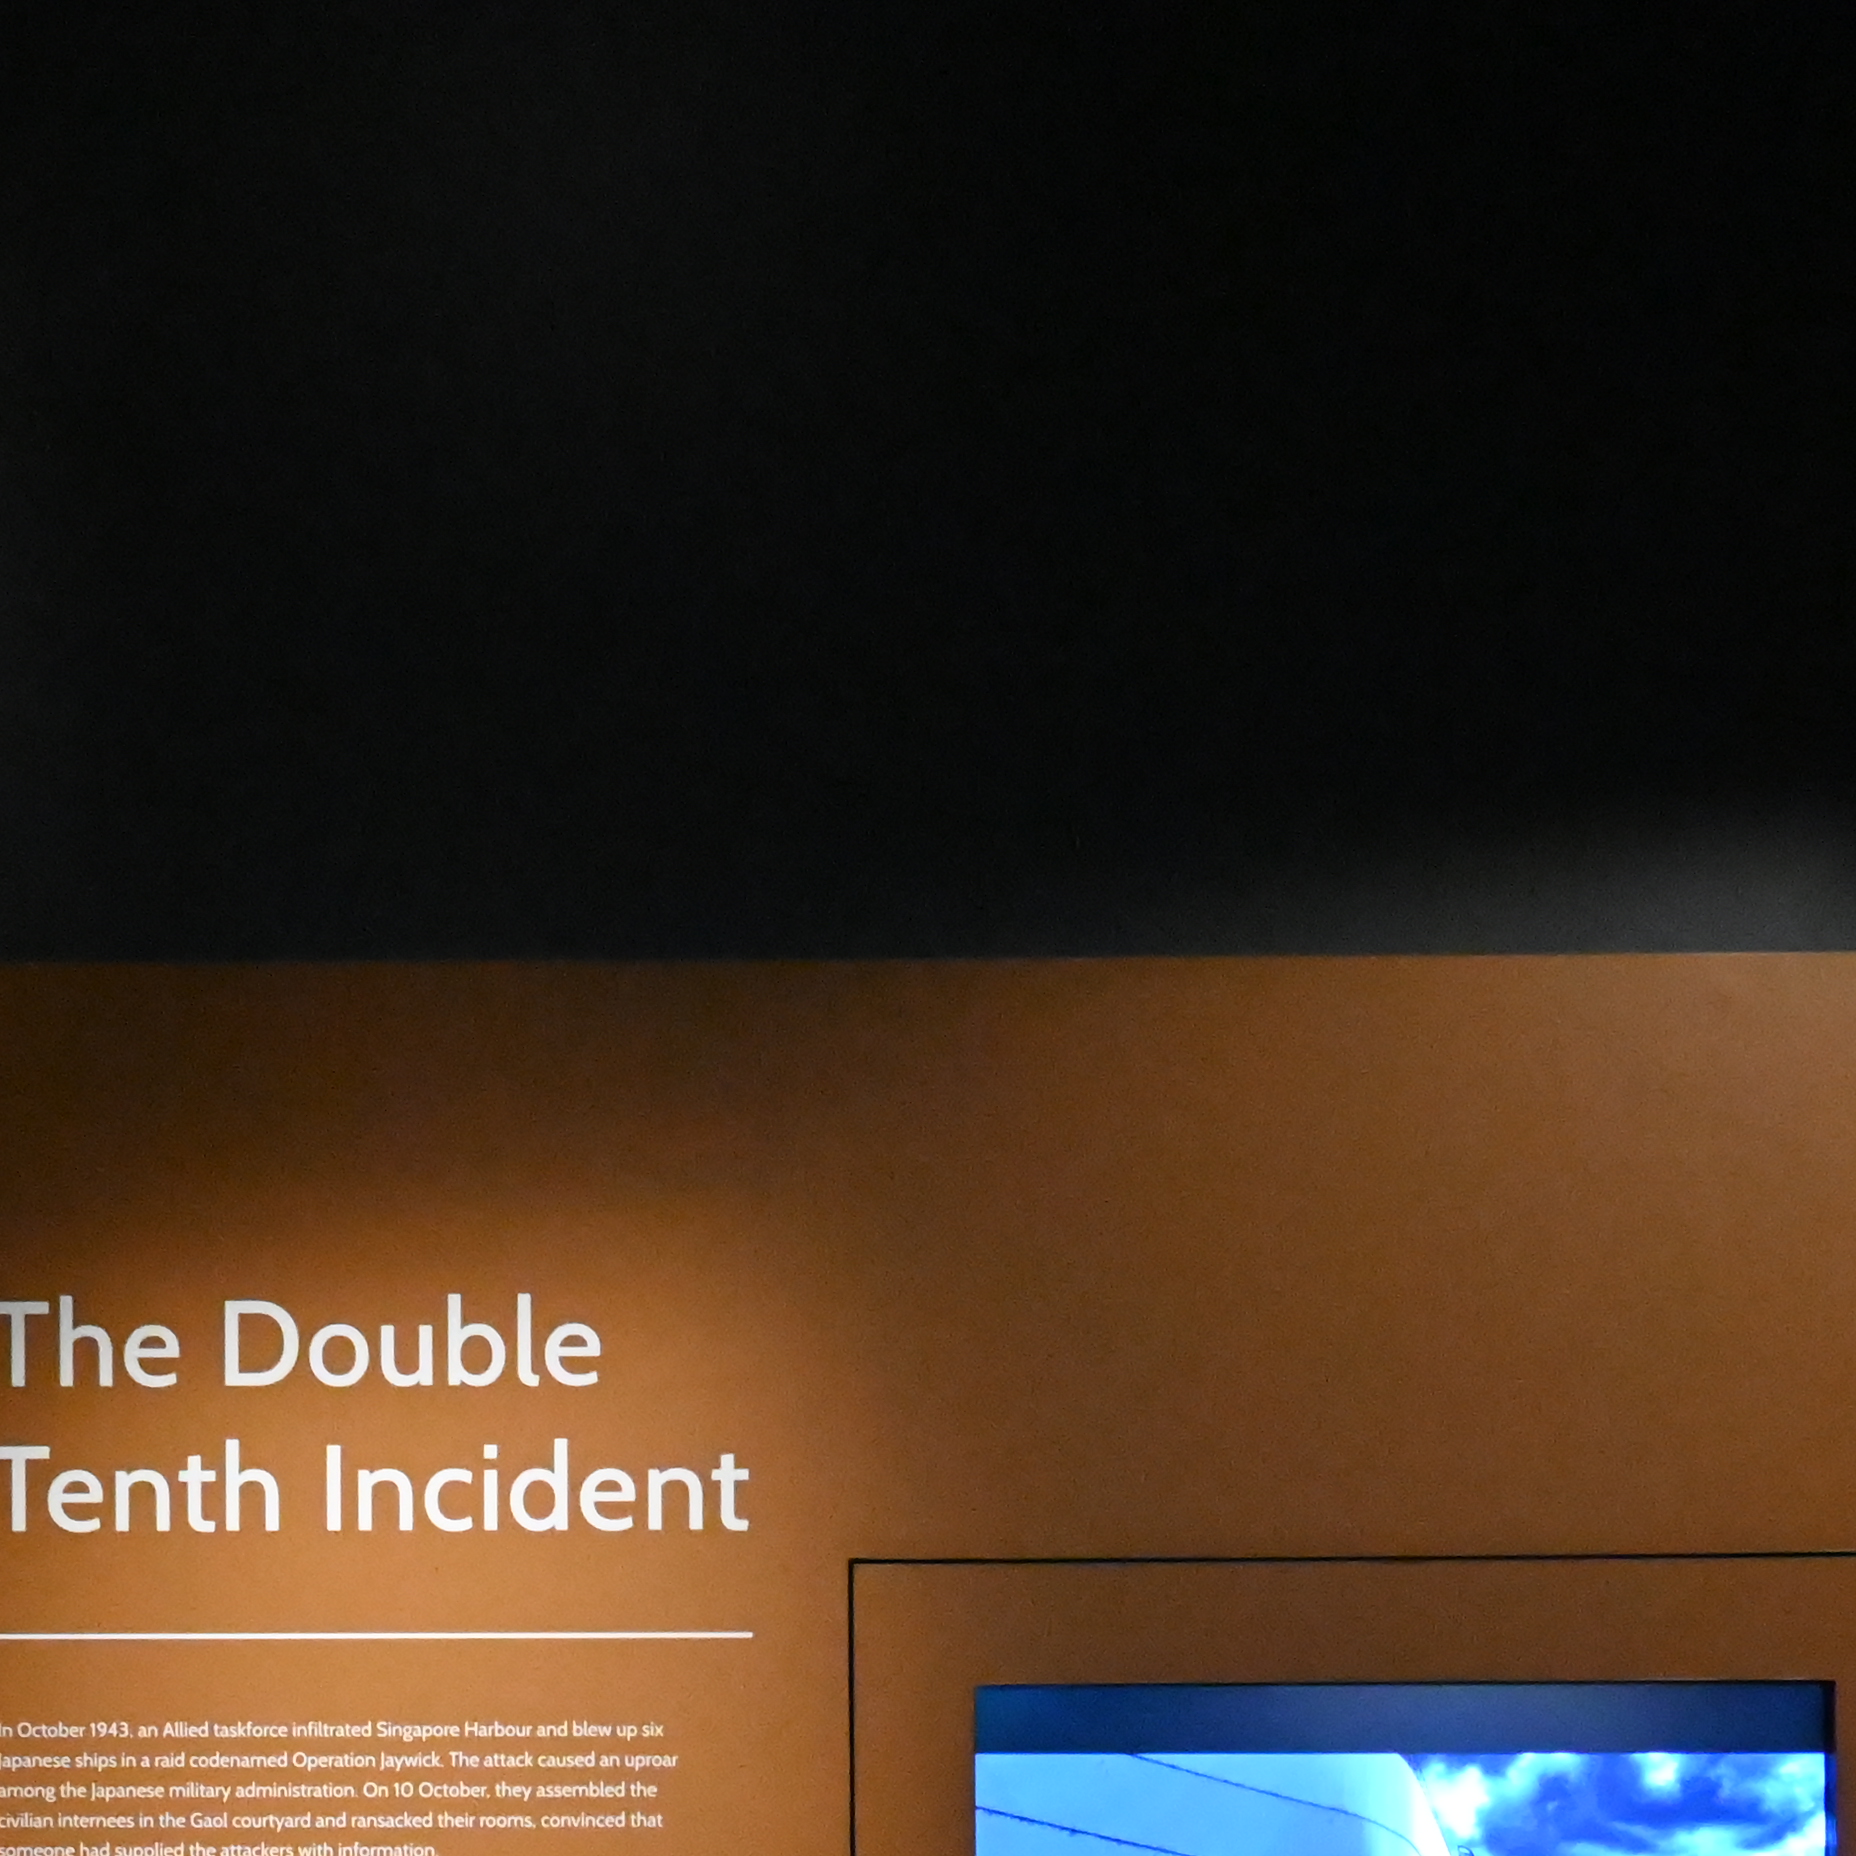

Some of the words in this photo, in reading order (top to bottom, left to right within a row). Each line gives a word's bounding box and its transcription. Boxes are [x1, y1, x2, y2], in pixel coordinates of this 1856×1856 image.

[225, 1294, 600, 1387] Double
[327, 1439, 749, 1531] Incident
[17, 1721, 86, 1738] October
[90, 1722, 133, 1738] 1943,
[138, 1726, 158, 1738] an
[163, 1721, 209, 1738] Allied
[214, 1721, 288, 1738] taskforce
[292, 1721, 372, 1737] infiltrated
[376, 1721, 460, 1742] Singapore
[465, 1721, 532, 1737] Harbour
[536, 1720, 568, 1737] and
[572, 1720, 611, 1737] blew
[616, 1725, 637, 1741] up
[642, 1722, 663, 1737] six
[75, 1752, 117, 1772] ships
[121, 1752, 136, 1767] in
[141, 1756, 150, 1767] a
[154, 1751, 185, 1768] raid
[189, 1751, 288, 1768] codenamed
[292, 1752, 376, 1772] Operation
[380, 1751, 444, 1771] Jaywick.
[449, 1751, 479, 1767] The
[483, 1751, 533, 1767] attack
[538, 1751, 595, 1767] caused
[599, 1755, 620, 1767] an
[625, 1755, 678, 1771] uproar
[59, 1781, 87, 1798] the
[91, 1783, 164, 1802] Japanese
[169, 1782, 231, 1803] military
[235, 1781, 358, 1798] administration.
[363, 1782, 389, 1797] On
[394, 1782, 413, 1797] 10
[419, 1781, 490, 1798] October,
[495, 1781, 532, 1801] they
[536, 1781, 625, 1797] assembled
[630, 1781, 657, 1797] the
[58, 1813, 135, 1828] internees
[139, 1813, 154, 1828] in
[159, 1812, 186, 1828] the
[190, 1812, 227, 1828] Gaol
[232, 1812, 311, 1832] courtyard
[315, 1812, 346, 1828] and
[351, 1811, 433, 1828] ransacked
[437, 1811, 475, 1828] their
[479, 1816, 536, 1828] rooms,
[541, 1811, 625, 1828] convinced
[630, 1811, 663, 1827] that
